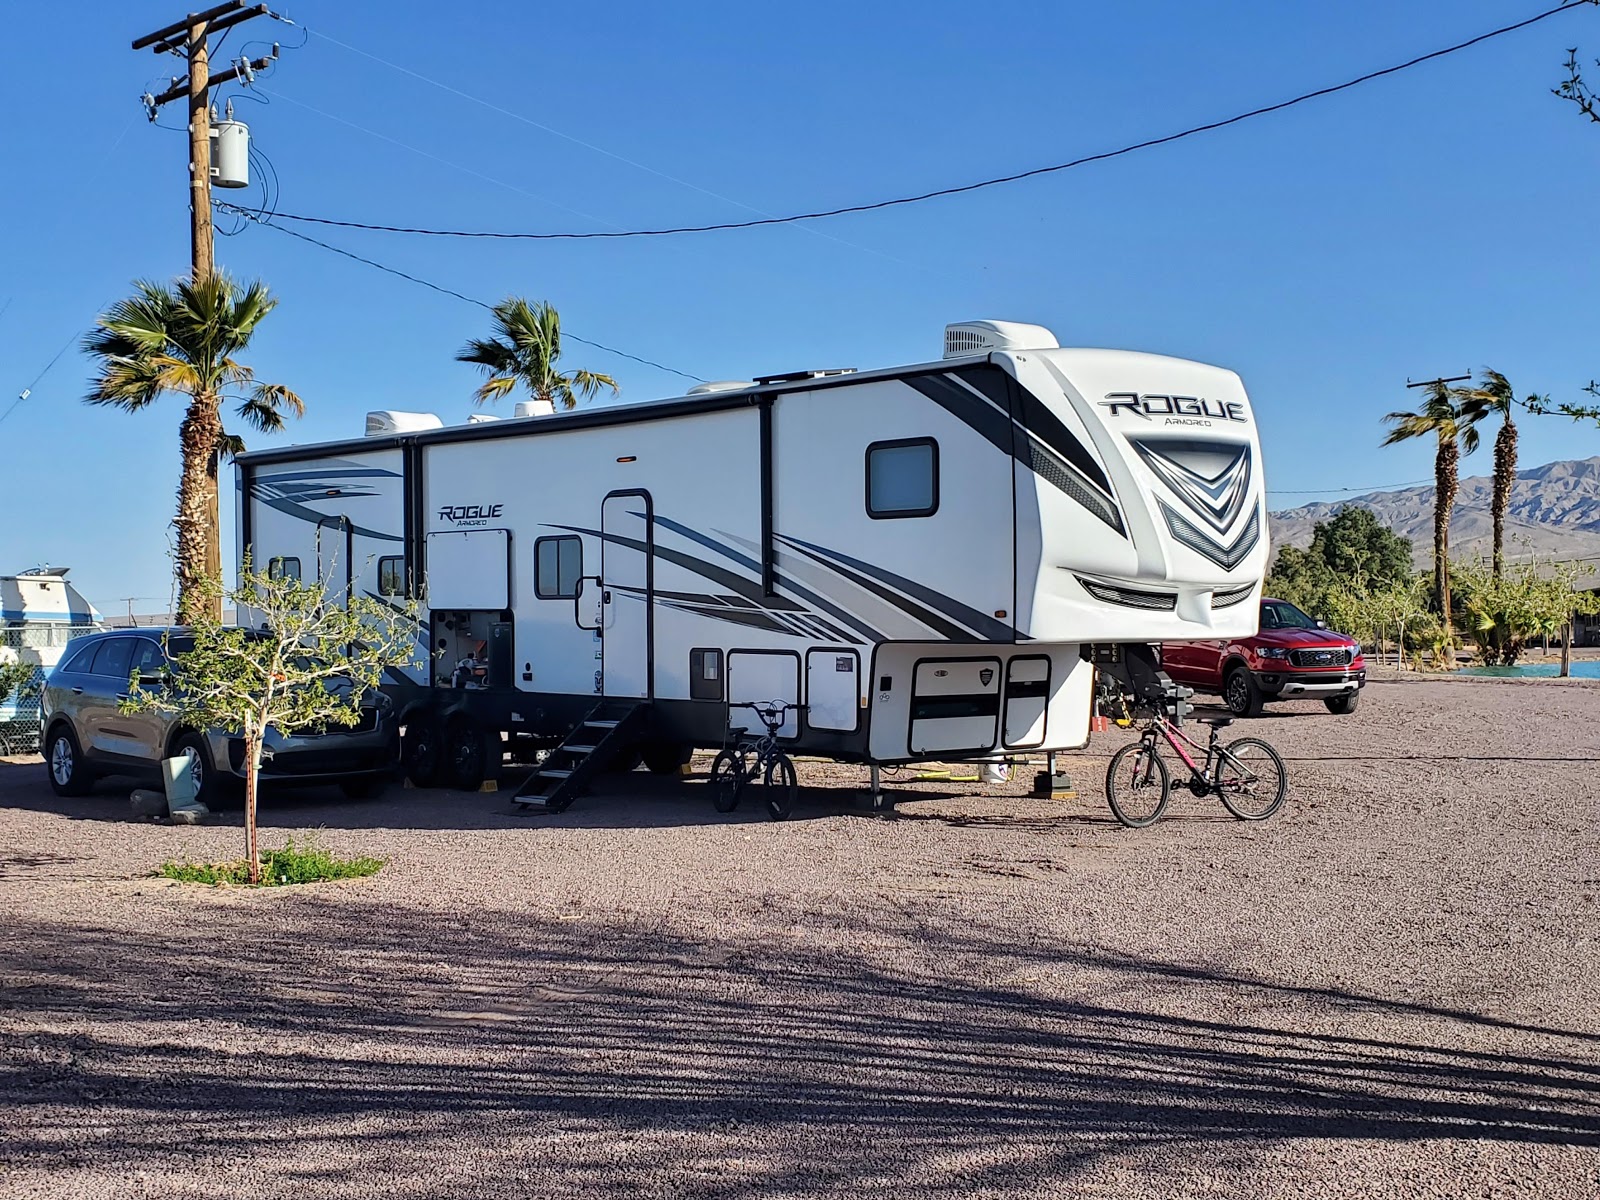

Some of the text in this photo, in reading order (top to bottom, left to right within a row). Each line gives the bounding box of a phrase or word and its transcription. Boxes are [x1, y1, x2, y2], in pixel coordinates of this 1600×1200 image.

[1097, 392, 1248, 424] ROGUE
[1165, 417, 1212, 427] ARMORED
[437, 504, 504, 523] ROGUE
